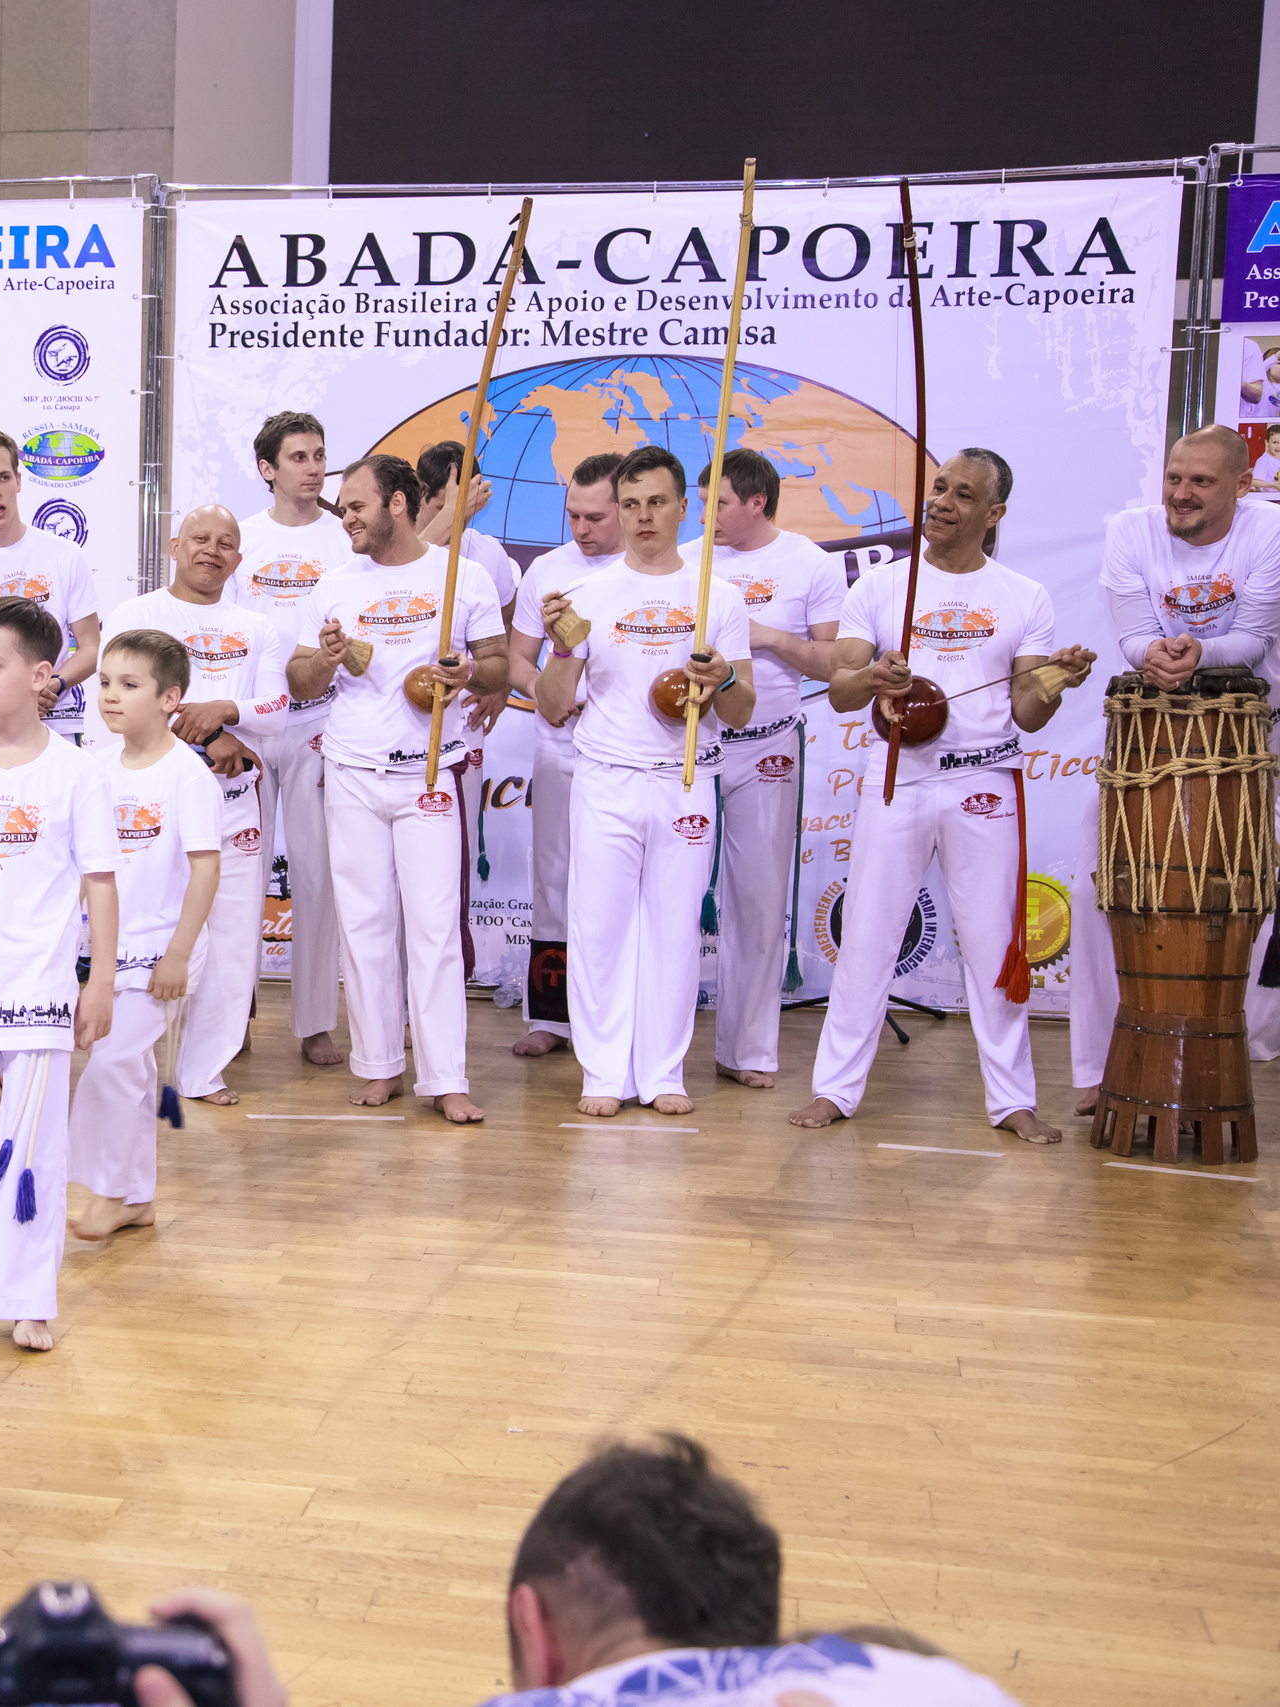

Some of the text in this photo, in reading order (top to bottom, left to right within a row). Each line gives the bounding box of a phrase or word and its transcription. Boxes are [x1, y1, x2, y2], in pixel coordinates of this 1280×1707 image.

[208, 212, 1136, 288] ABADÁ-CAPOEIRA
[3, 275, 115, 295] Arte-Capoeira
[209, 292, 346, 320] Associação
[354, 291, 477, 315] Brasileira
[487, 290, 516, 312] de
[526, 289, 605, 319] Apoio
[614, 295, 627, 311] e
[637, 286, 879, 311] Desenvolvimento
[930, 280, 1136, 313] Arte-Capoeira
[209, 321, 364, 348] Presidente
[374, 319, 530, 348] Fundador:
[541, 319, 648, 346] Mestre
[61, 421, 100, 440] SAMARA
[22, 453, 101, 465] ABADÁ-CAPOEIRA
[28, 476, 64, 489] GRADUADO
[256, 578, 316, 587] ABADÁ-CAPOEIRA
[362, 613, 432, 624] ABADÁ-CAPOEIRA
[620, 624, 692, 634] ABADÁ-CAPOEIRA
[914, 628, 989, 638] ABADÁ-CAPOEIRA
